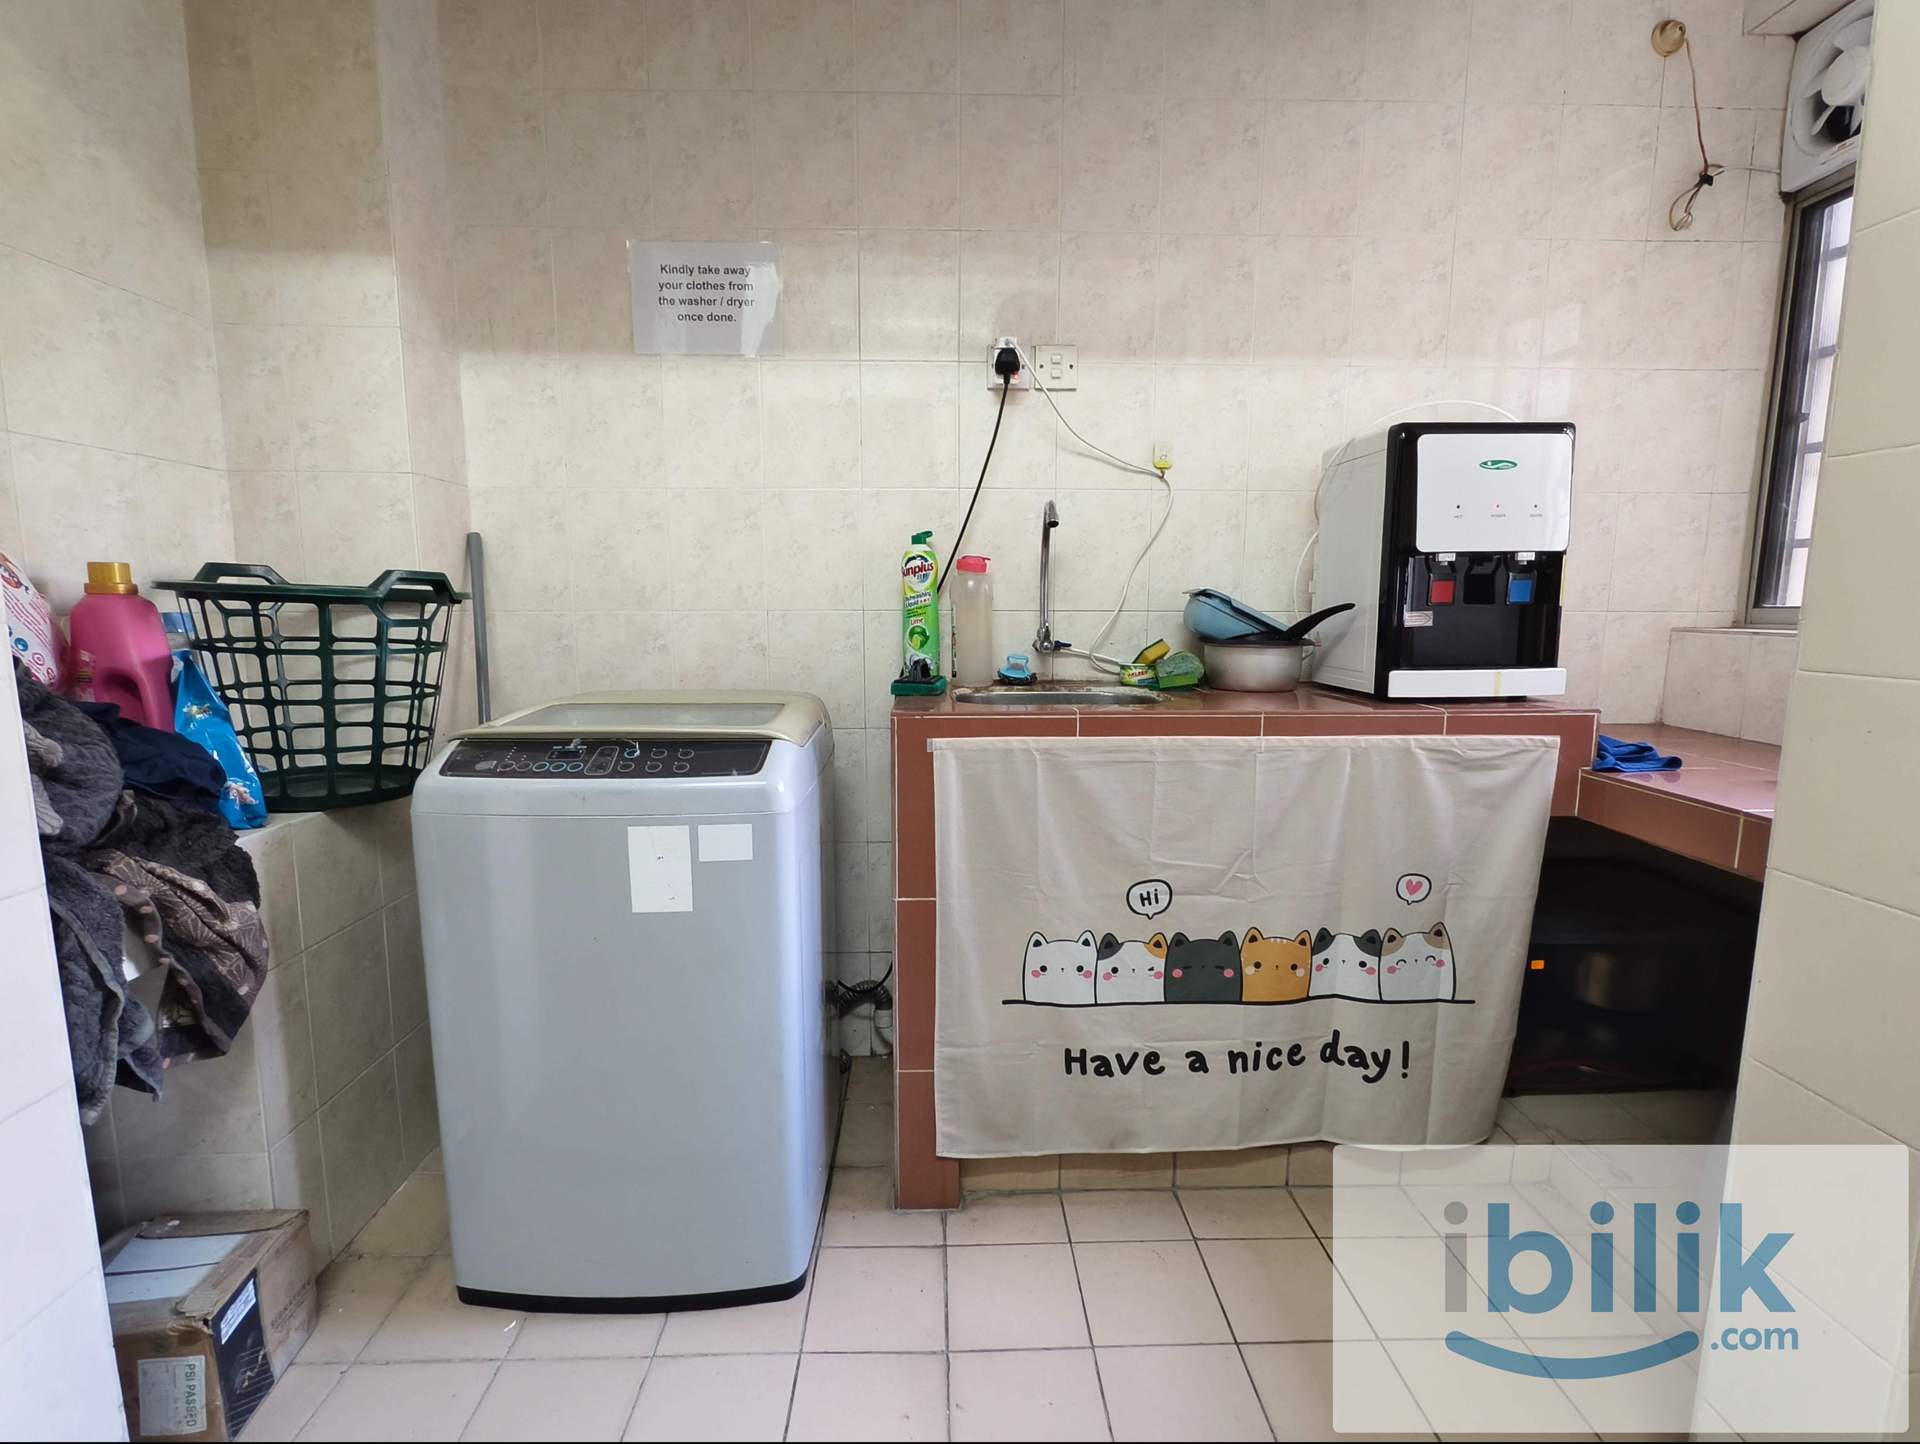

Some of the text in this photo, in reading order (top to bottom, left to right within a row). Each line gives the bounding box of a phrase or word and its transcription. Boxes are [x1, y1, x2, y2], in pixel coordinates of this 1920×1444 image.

[660, 264, 751, 277] Kindly take away
[658, 281, 753, 292] your clothes from
[658, 296, 755, 308] the washer / dryer
[677, 312, 737, 322] once done.
[1139, 889, 1160, 908] Hi
[1064, 1029, 1410, 1084] Have a nice day!
[184, 1363, 198, 1428] PSI PASSED
